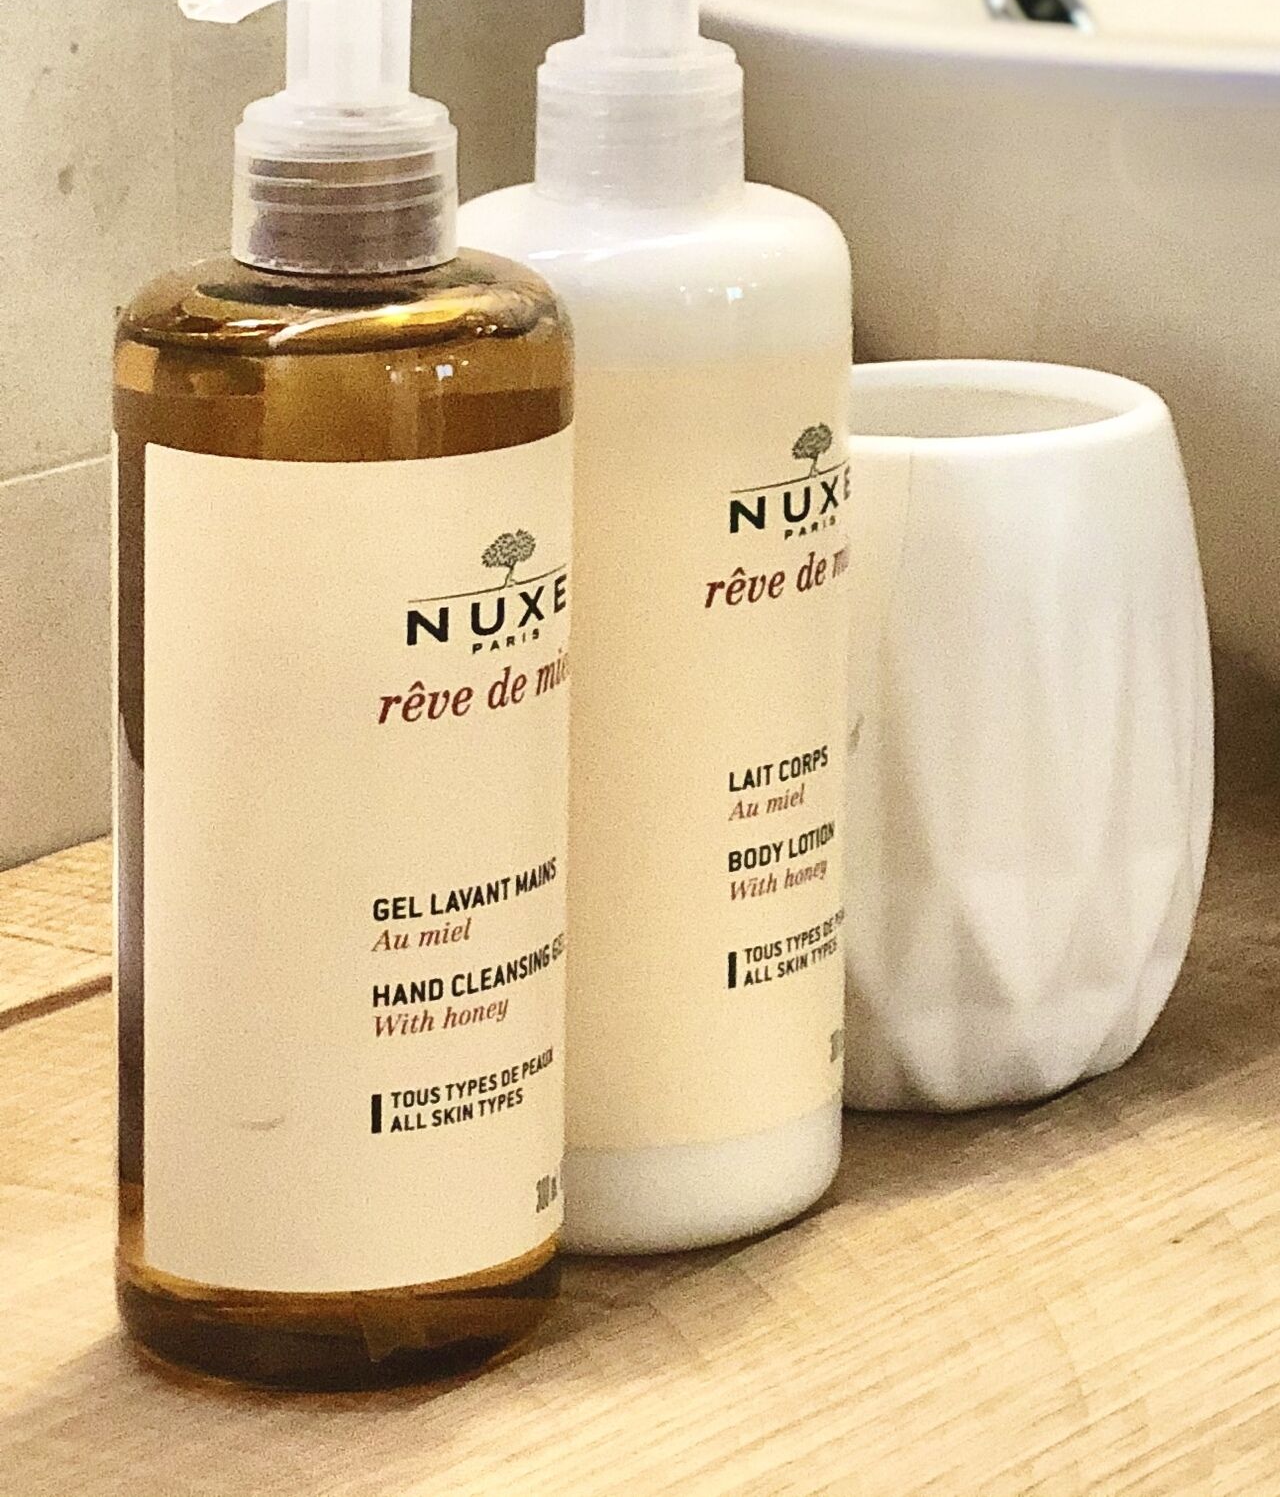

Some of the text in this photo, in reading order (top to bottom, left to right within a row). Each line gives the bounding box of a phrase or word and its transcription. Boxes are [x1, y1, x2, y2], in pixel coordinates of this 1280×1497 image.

[784, 515, 836, 540] PARIS
[705, 567, 785, 609] rêve
[796, 552, 827, 592] de
[407, 573, 567, 645] NUXE
[472, 628, 540, 654] PARIS
[378, 681, 474, 725] rêve
[487, 665, 527, 710] de
[729, 745, 829, 792] LAIT CORPS
[728, 783, 805, 821] Au miel
[729, 820, 835, 873] BODY LOTION
[373, 856, 557, 921] GEL LAVANT MAINS
[730, 859, 828, 902] With honey
[371, 917, 473, 953] Au miel
[744, 940, 783, 965] TOUS
[786, 925, 820, 953] TYPES
[373, 977, 445, 1008] HAND
[451, 944, 550, 998] CLEANSING
[743, 965, 773, 987] ALL
[777, 954, 808, 979] SKIN
[373, 998, 510, 1038] With honey
[390, 1087, 524, 1133] ALL SKIN TYPES
[391, 1085, 441, 1110] TOUS
[445, 1072, 498, 1102] TYPES
[501, 1064, 520, 1084] DE
